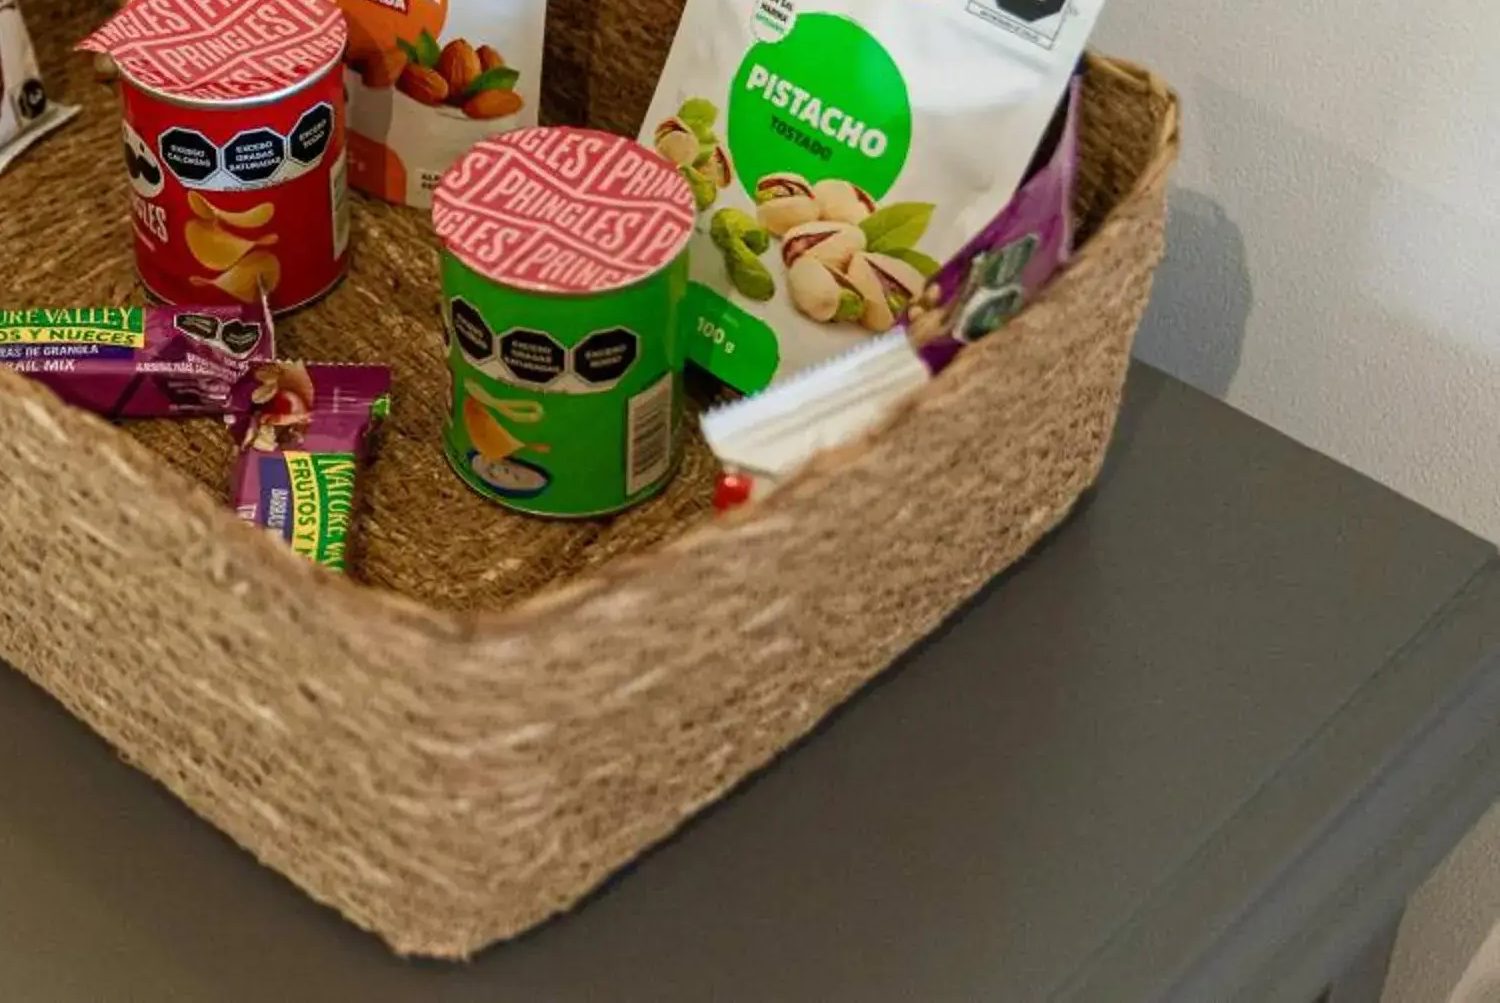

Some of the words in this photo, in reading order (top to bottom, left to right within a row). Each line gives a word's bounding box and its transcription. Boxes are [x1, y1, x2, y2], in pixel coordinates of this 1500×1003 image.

[157, 3, 300, 79] PRINGLES
[746, 63, 888, 159] PISTACHO
[770, 115, 834, 163] TOSTADO
[481, 168, 645, 250] PRINGLES
[30, 328, 45, 341] Y
[49, 329, 137, 345] NUECES
[44, 308, 134, 331] VALLEY
[697, 316, 726, 345] 100
[723, 340, 736, 354] g
[24, 347, 41, 358] DE
[43, 343, 100, 357] GRANOLA
[43, 359, 76, 372] MIX
[290, 458, 317, 527] FRUTOS
[295, 529, 316, 542] Y
